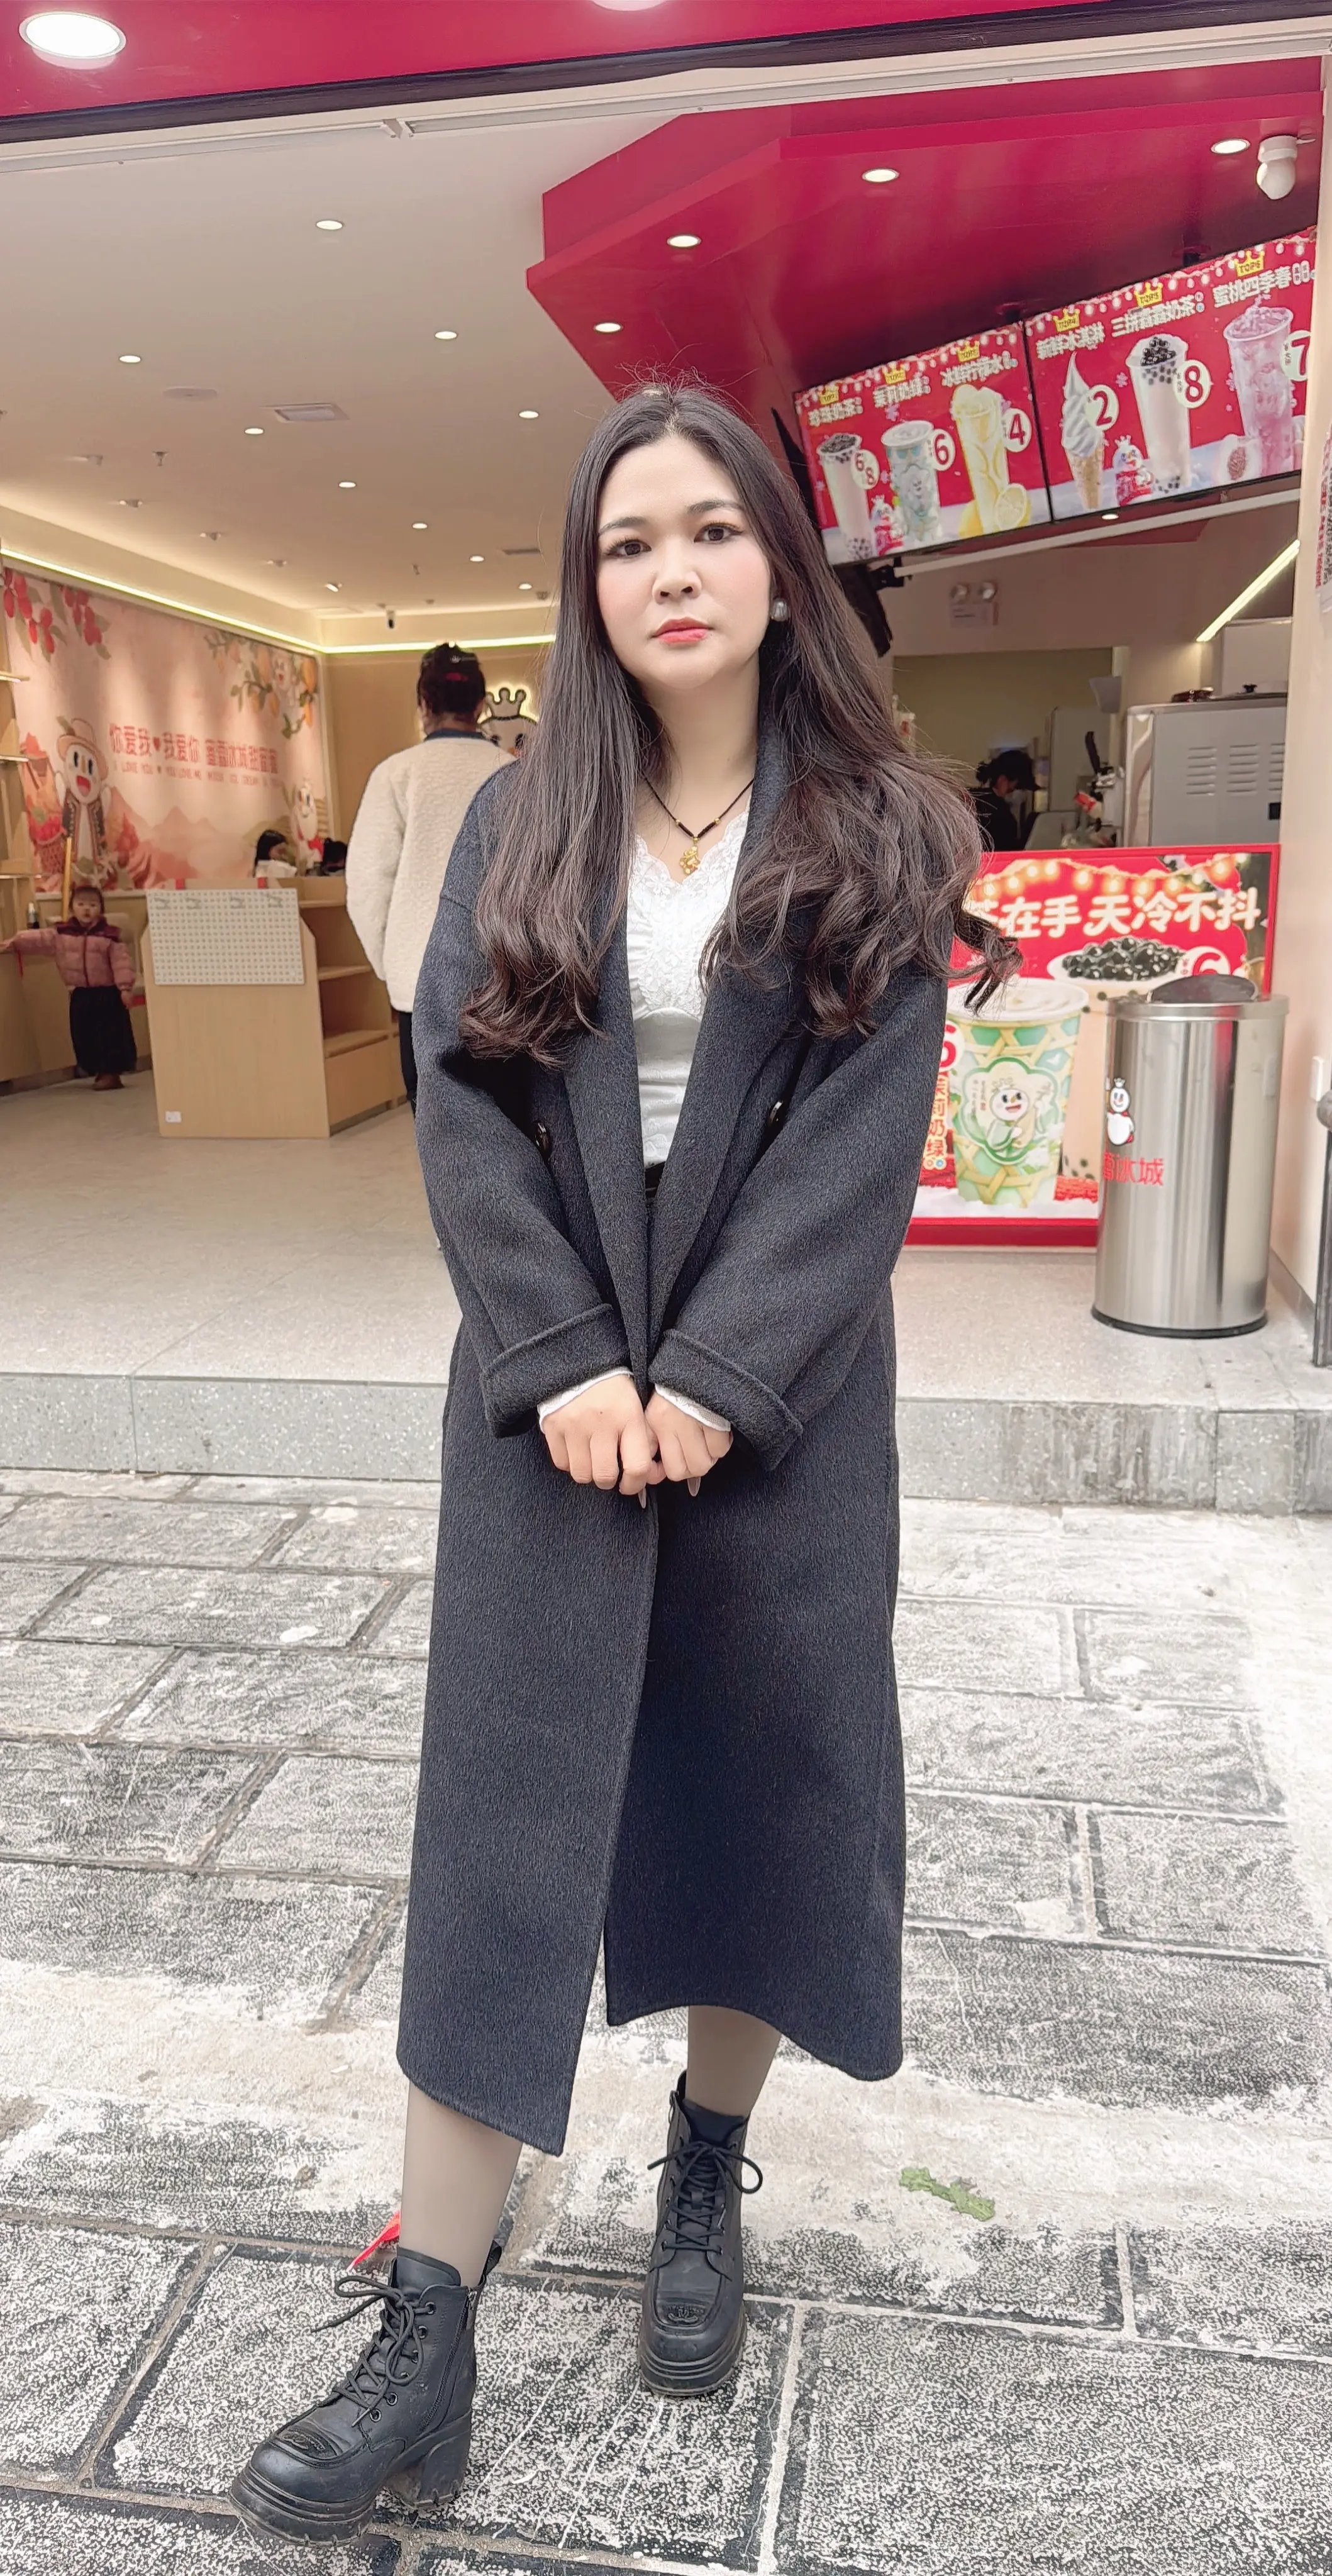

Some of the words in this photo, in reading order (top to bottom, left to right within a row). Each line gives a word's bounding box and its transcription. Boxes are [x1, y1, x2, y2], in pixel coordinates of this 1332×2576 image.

[1292, 336, 1311, 375] 7
[1184, 365, 1203, 402] 8
[1092, 390, 1113, 426] 2
[1009, 413, 1026, 445] 4
[933, 433, 950, 465] 6
[1082, 887, 1262, 936] 天冷不抖
